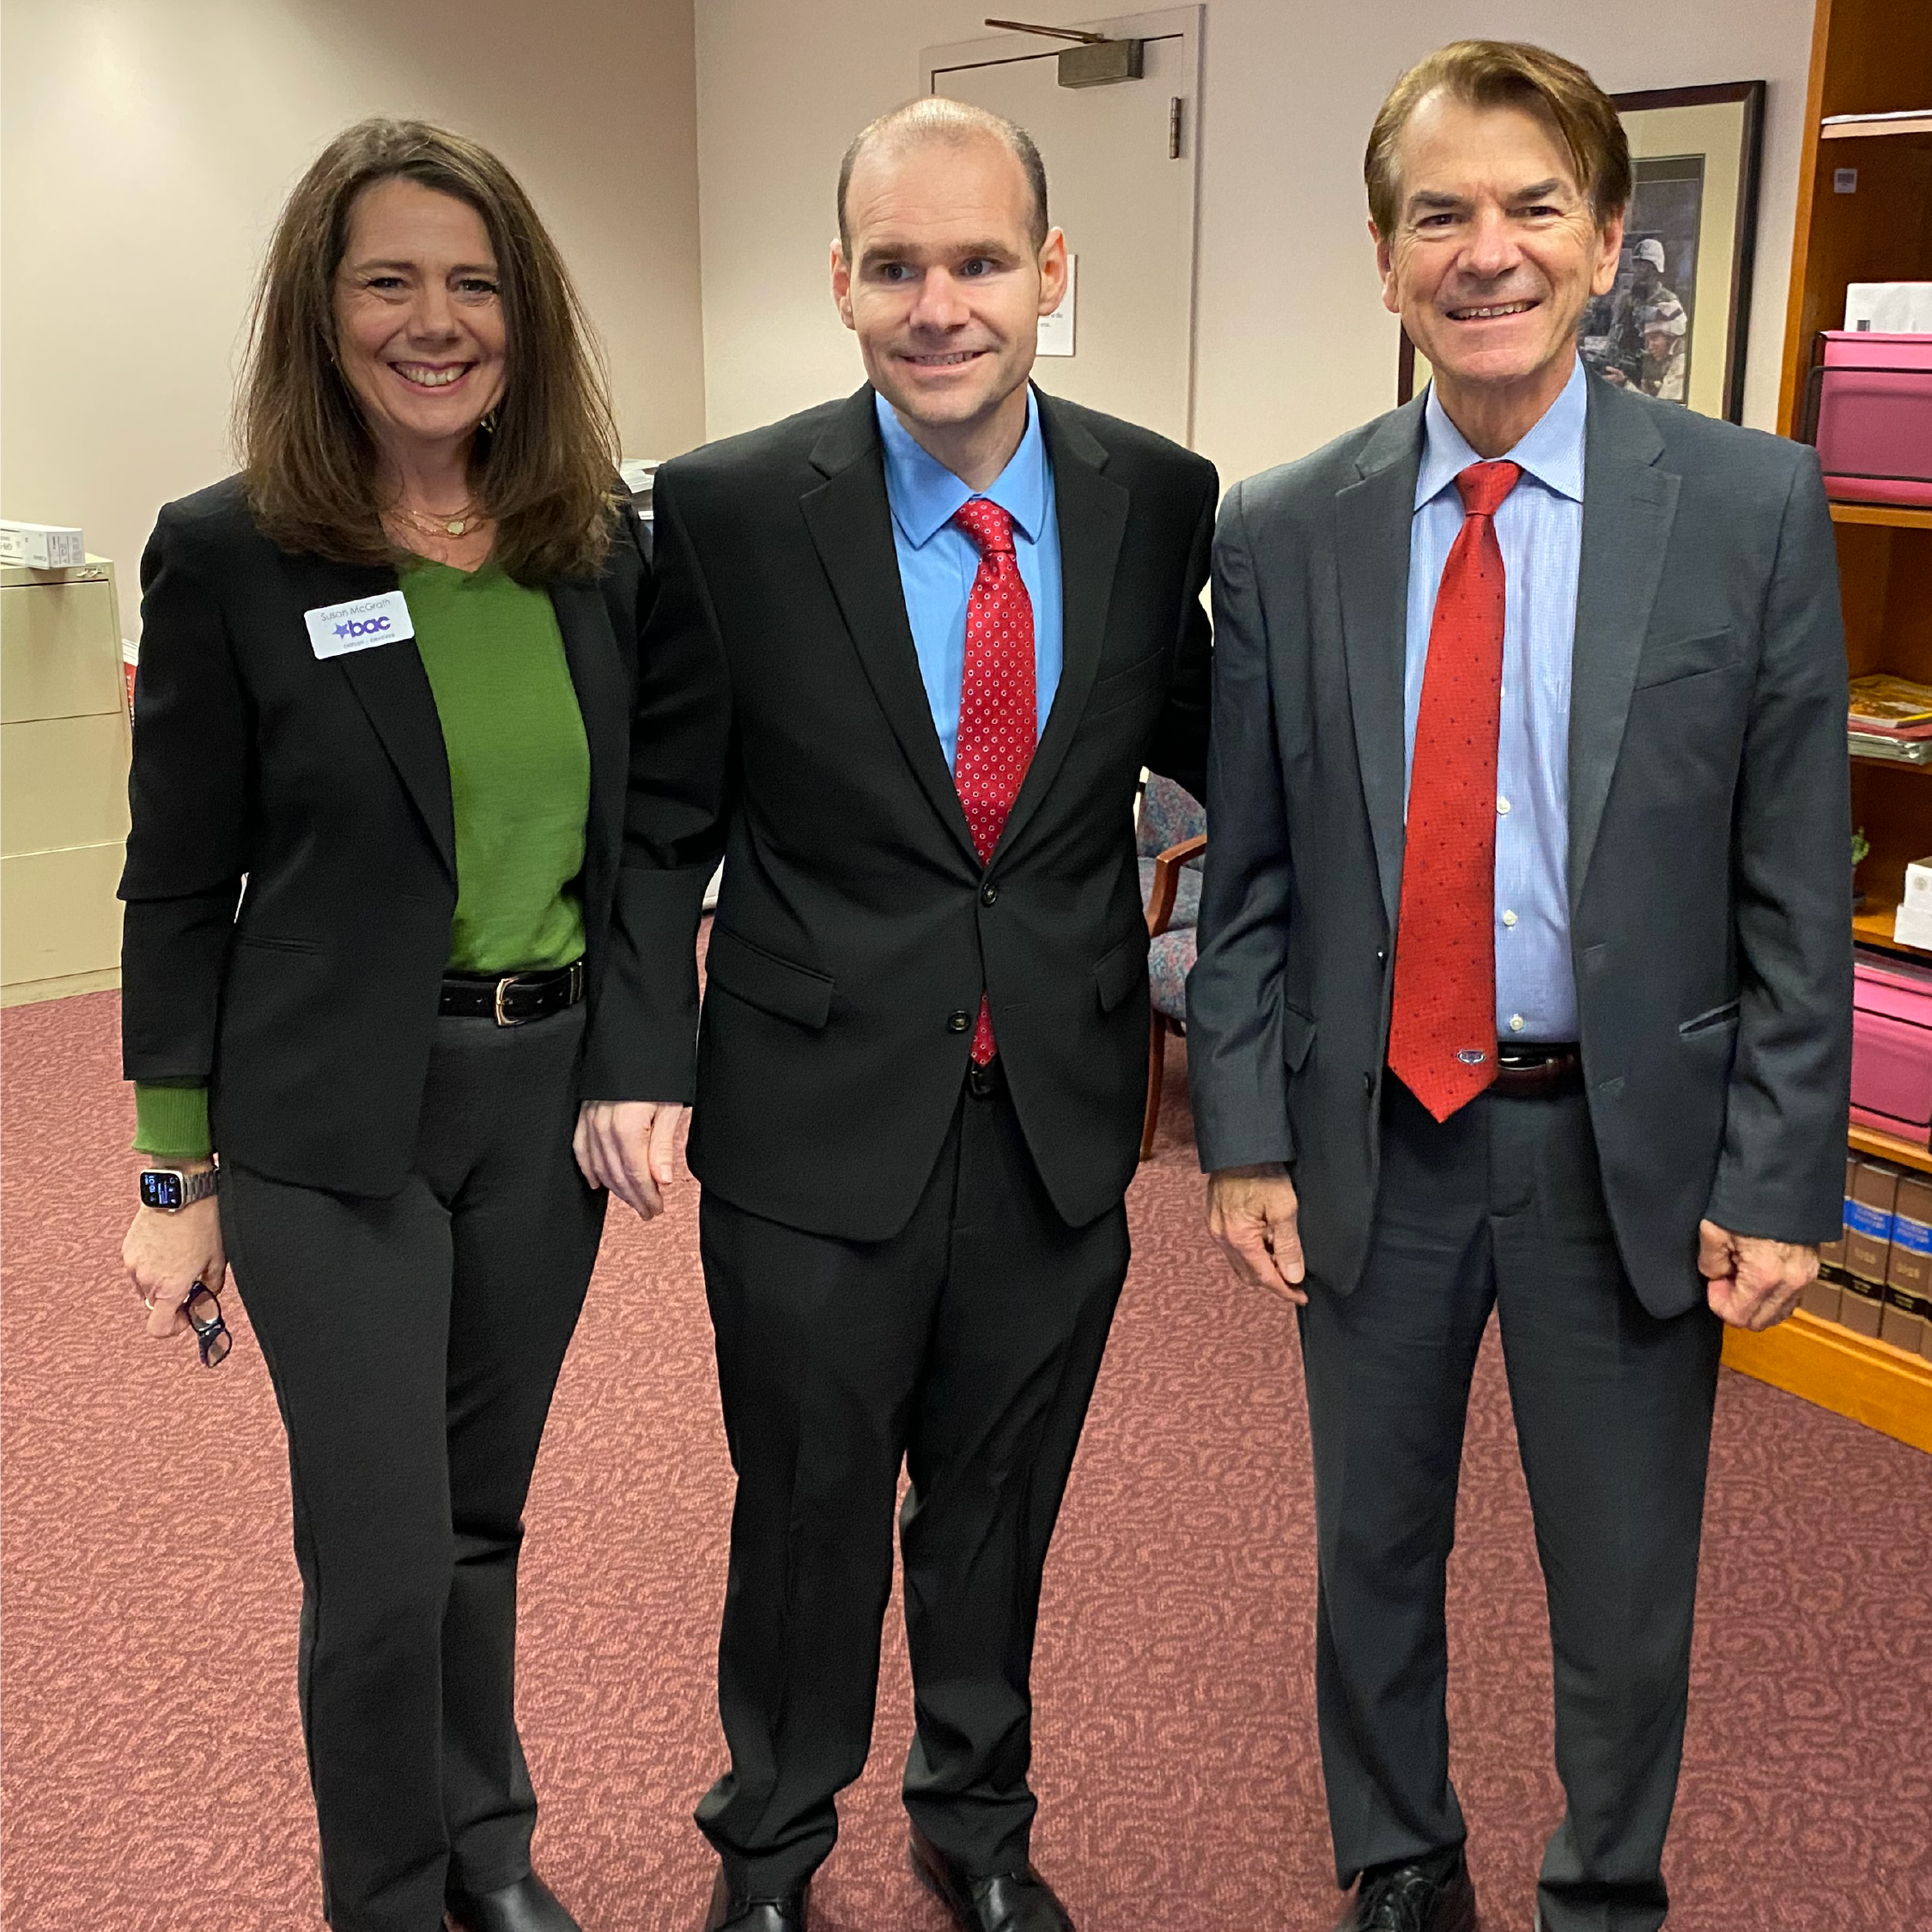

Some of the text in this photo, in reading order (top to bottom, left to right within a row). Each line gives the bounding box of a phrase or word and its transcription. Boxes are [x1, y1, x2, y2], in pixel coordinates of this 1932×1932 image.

[321, 598, 391, 622] Susan McGrath
[347, 616, 391, 638] bac
